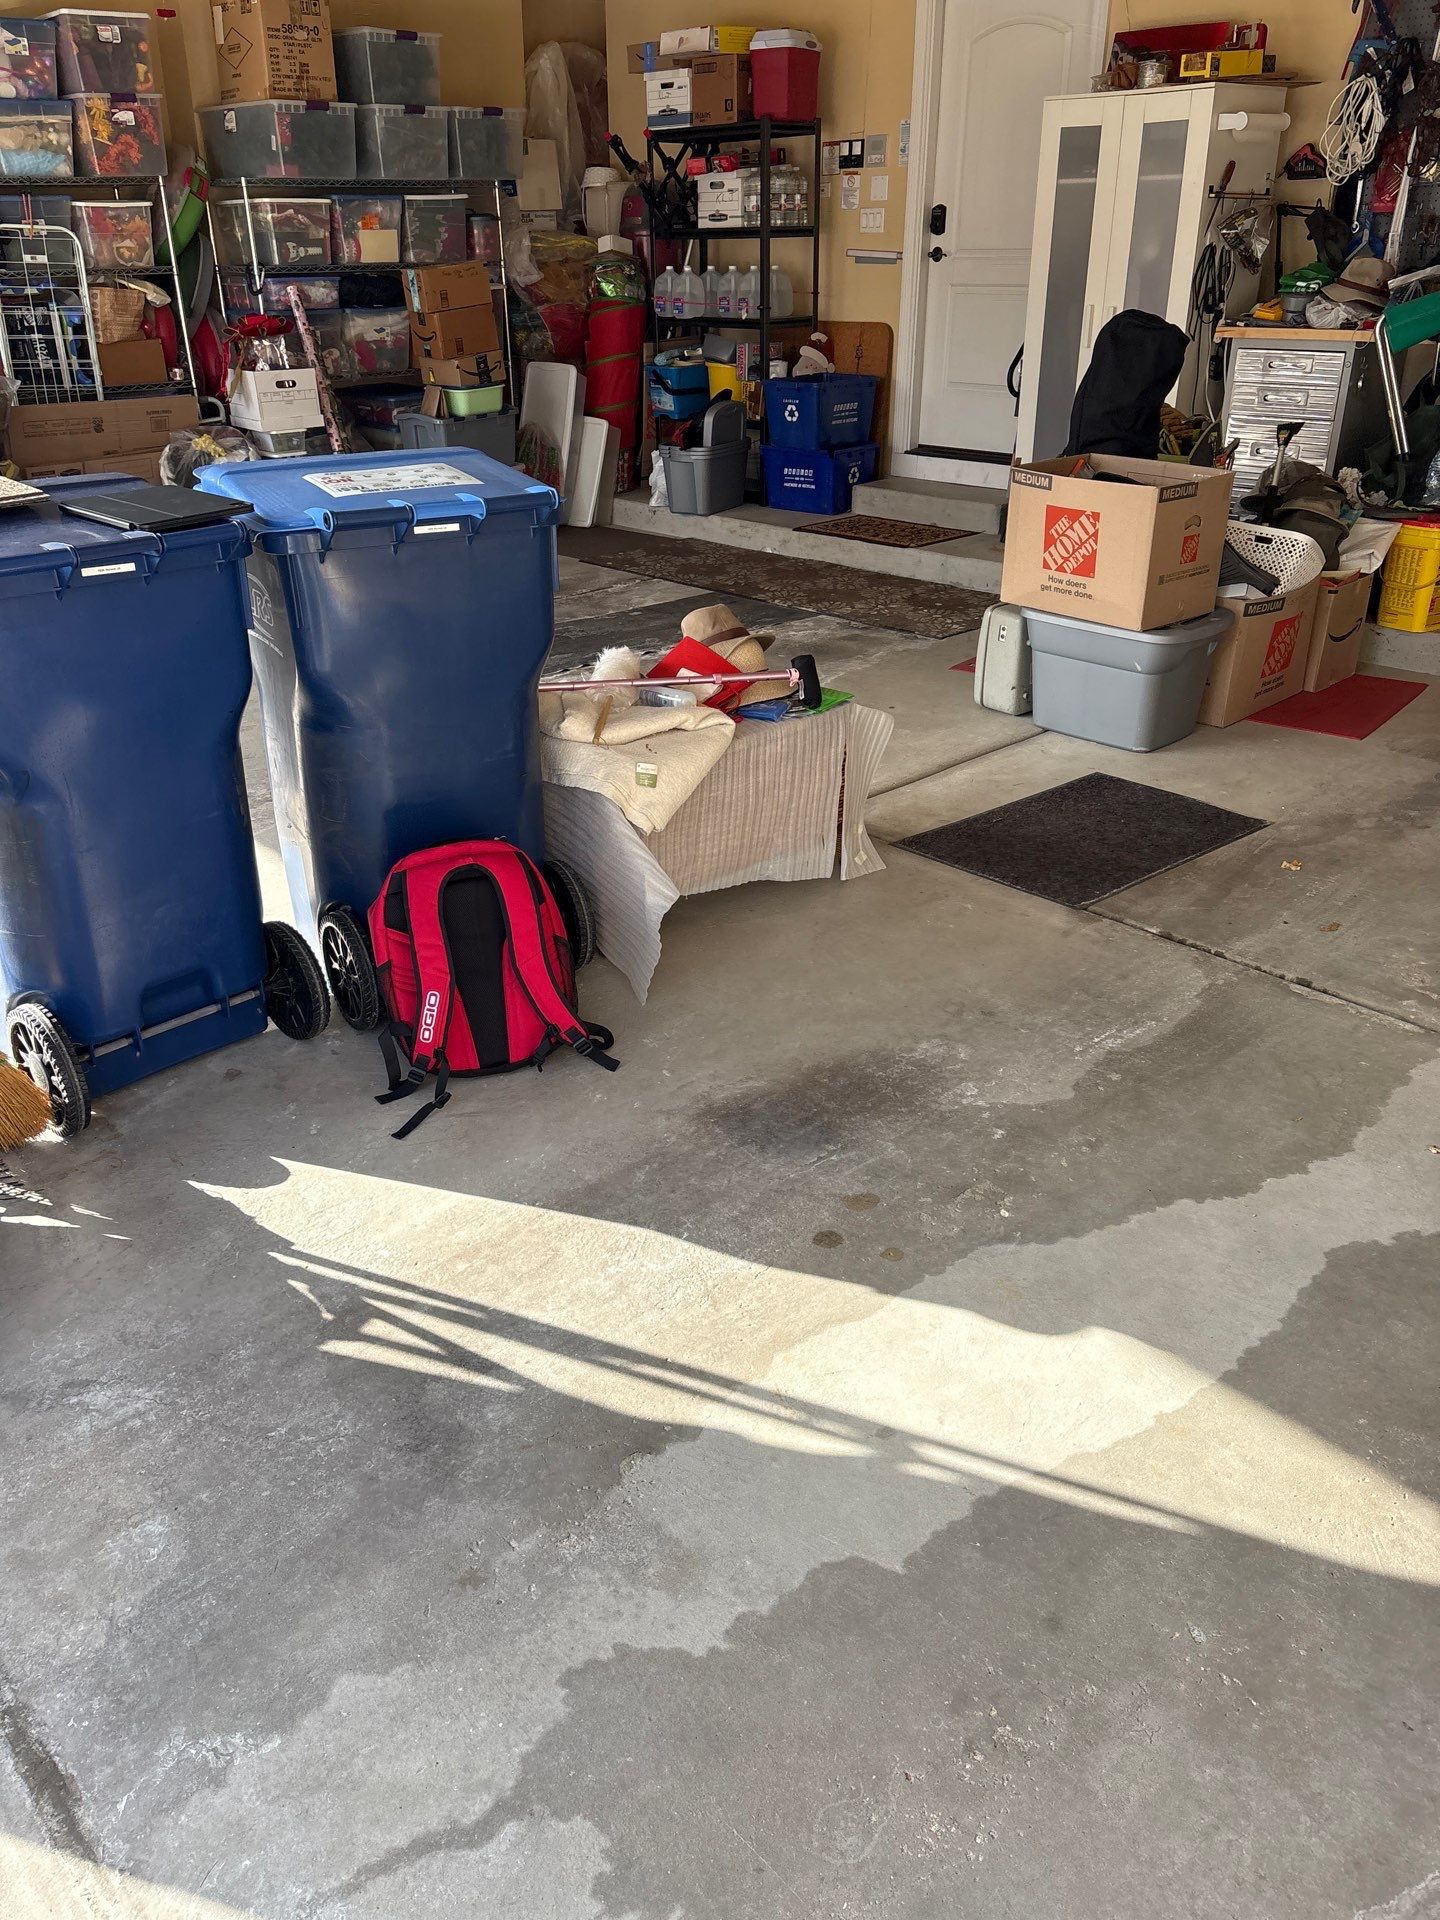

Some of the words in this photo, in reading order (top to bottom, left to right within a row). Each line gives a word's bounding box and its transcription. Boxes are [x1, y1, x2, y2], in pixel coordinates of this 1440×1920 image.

[1014, 471, 1049, 488] MEDIUM
[1162, 484, 1196, 500] MEDIUM
[1049, 514, 1072, 539] THE
[1043, 511, 1099, 571] HOME
[1062, 536, 1098, 574] DEPOT
[1048, 574, 1065, 585] How
[1065, 579, 1087, 589] doers
[1040, 584, 1052, 592] get
[1053, 586, 1073, 595] more
[1073, 590, 1095, 600] done.
[1247, 600, 1282, 614] MEDIUM
[1261, 679, 1272, 688] How
[420, 991, 440, 1044] OGIO
